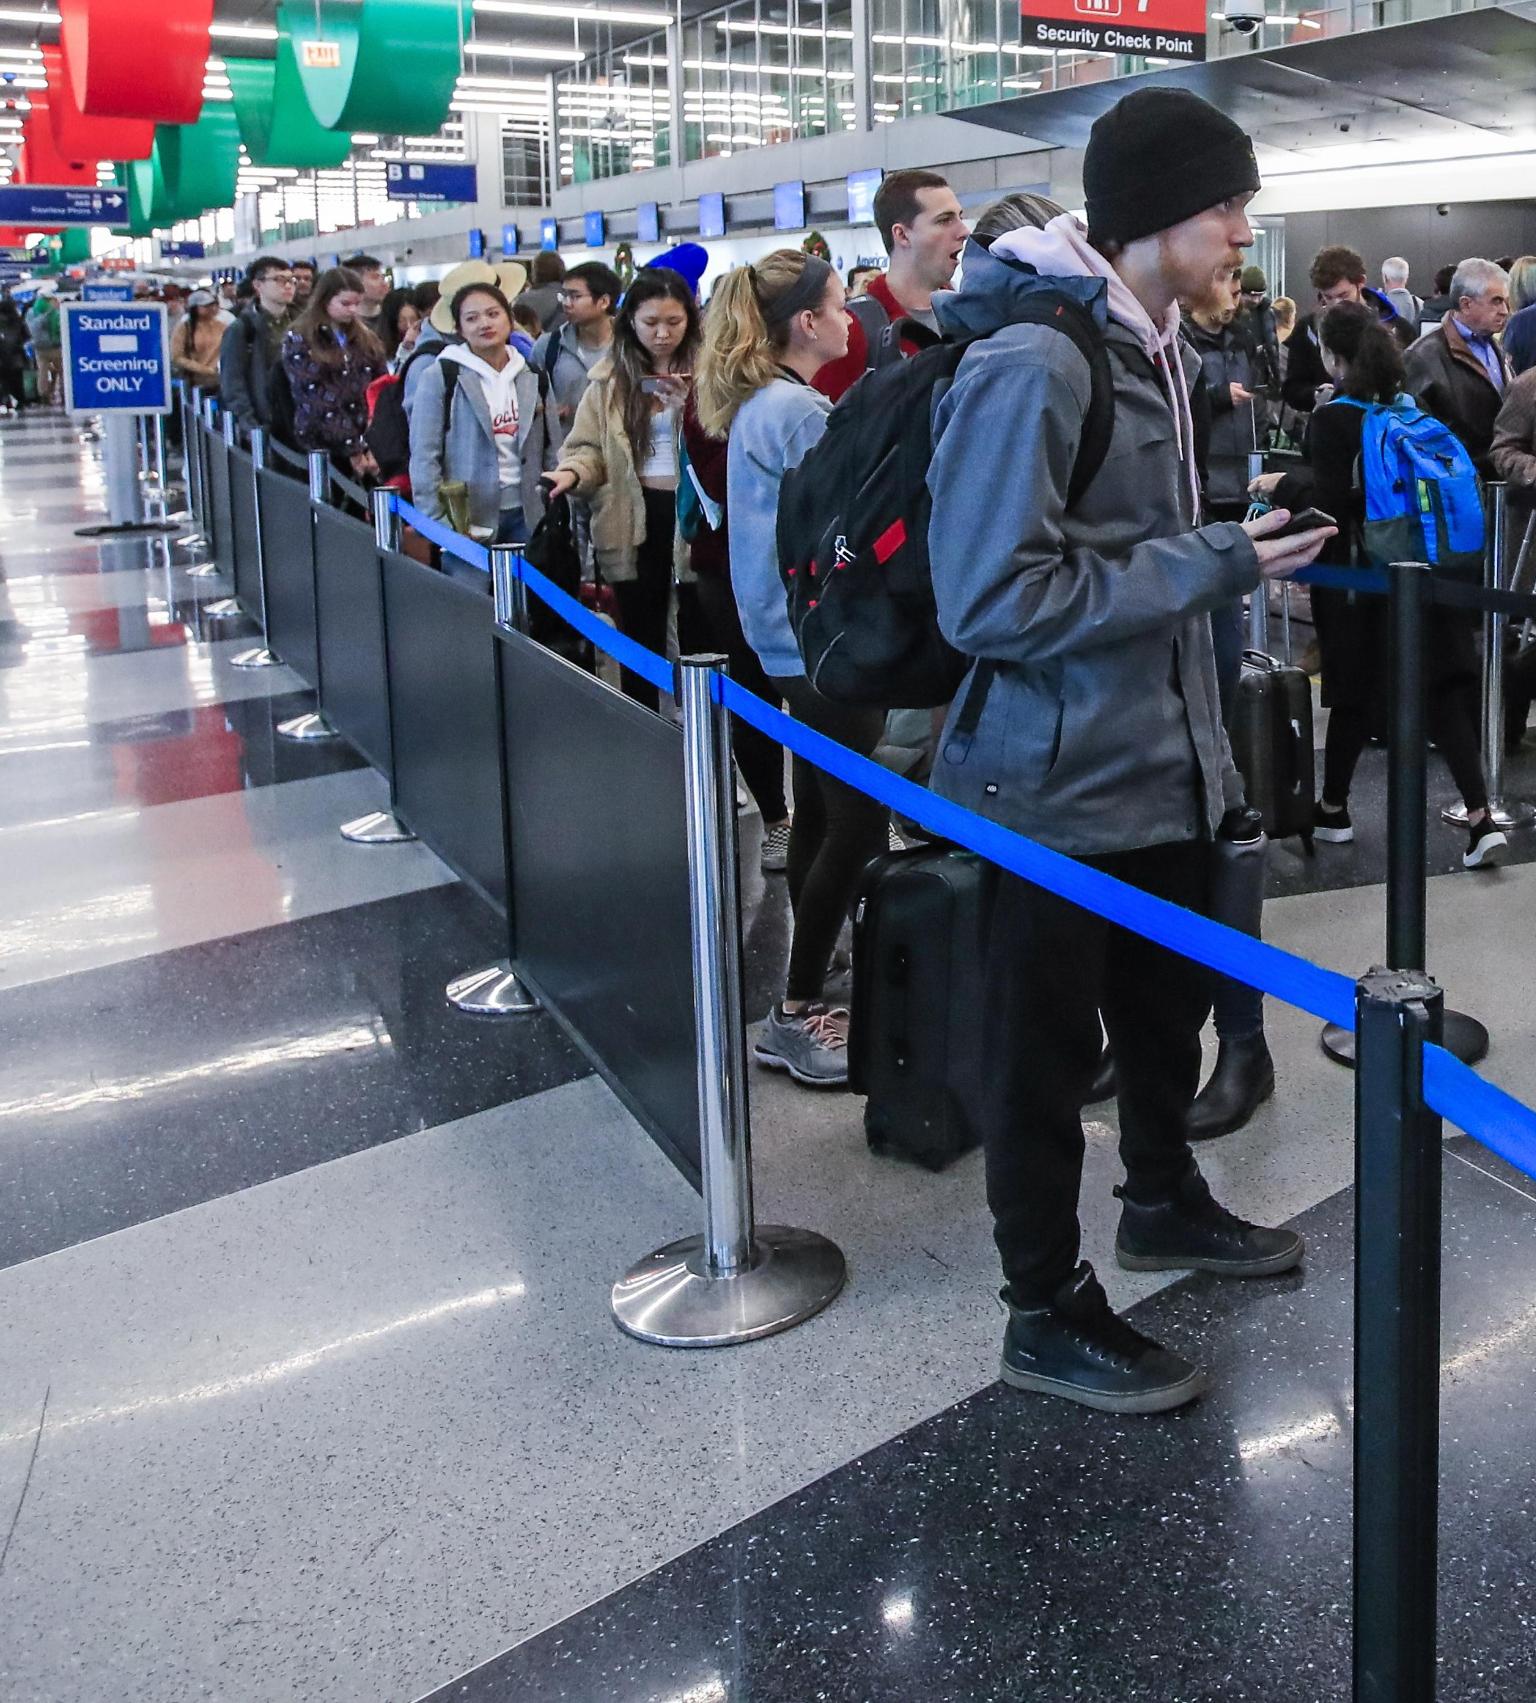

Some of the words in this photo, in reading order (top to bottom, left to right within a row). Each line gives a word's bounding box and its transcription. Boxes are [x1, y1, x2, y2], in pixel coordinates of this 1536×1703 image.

[1036, 24, 1100, 47] Security
[1104, 31, 1152, 49] Check
[1156, 36, 1194, 53] Point
[79, 314, 151, 331] Standard
[79, 357, 159, 374] Screening
[96, 377, 144, 393] ONLY
